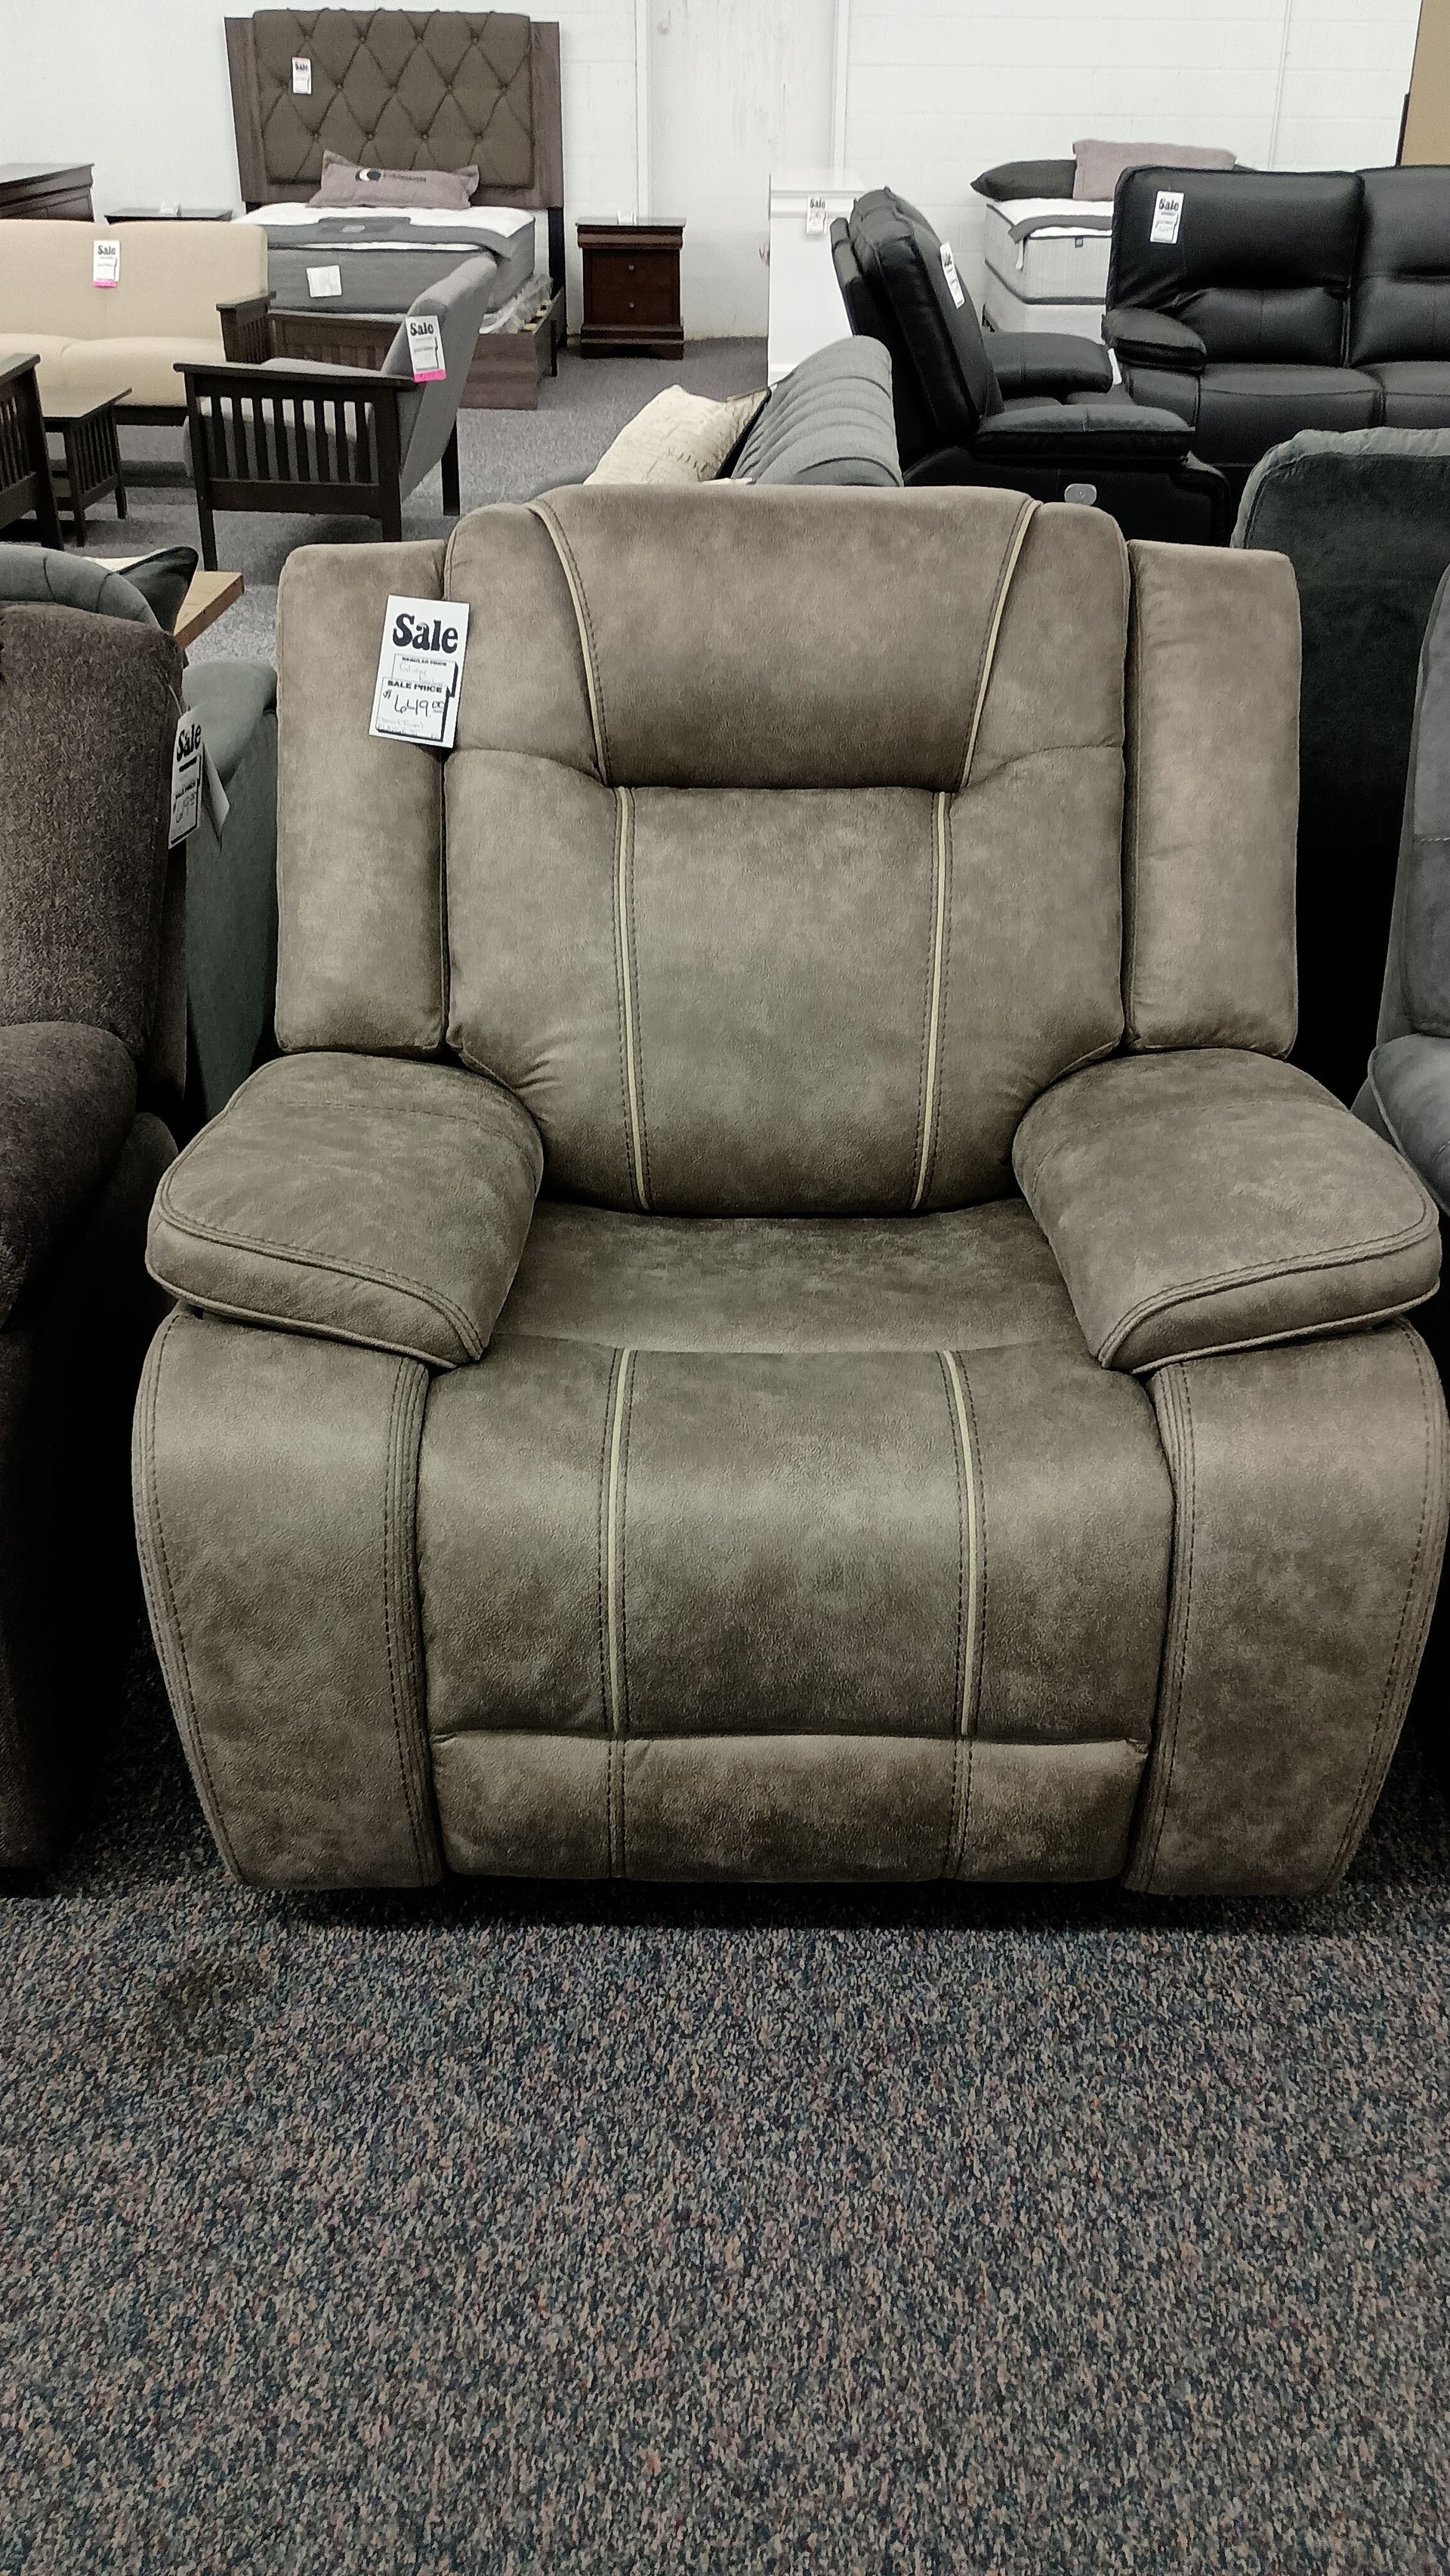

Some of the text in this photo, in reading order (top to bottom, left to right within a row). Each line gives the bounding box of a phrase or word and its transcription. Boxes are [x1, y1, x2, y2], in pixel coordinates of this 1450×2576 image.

[1159, 199, 1179, 211] Sale
[97, 245, 116, 255] Sale
[410, 322, 434, 336] Sale
[393, 612, 458, 654] Sale
[387, 680, 412, 689] SALE
[414, 683, 443, 693] PRICE
[176, 723, 202, 762] Sale
